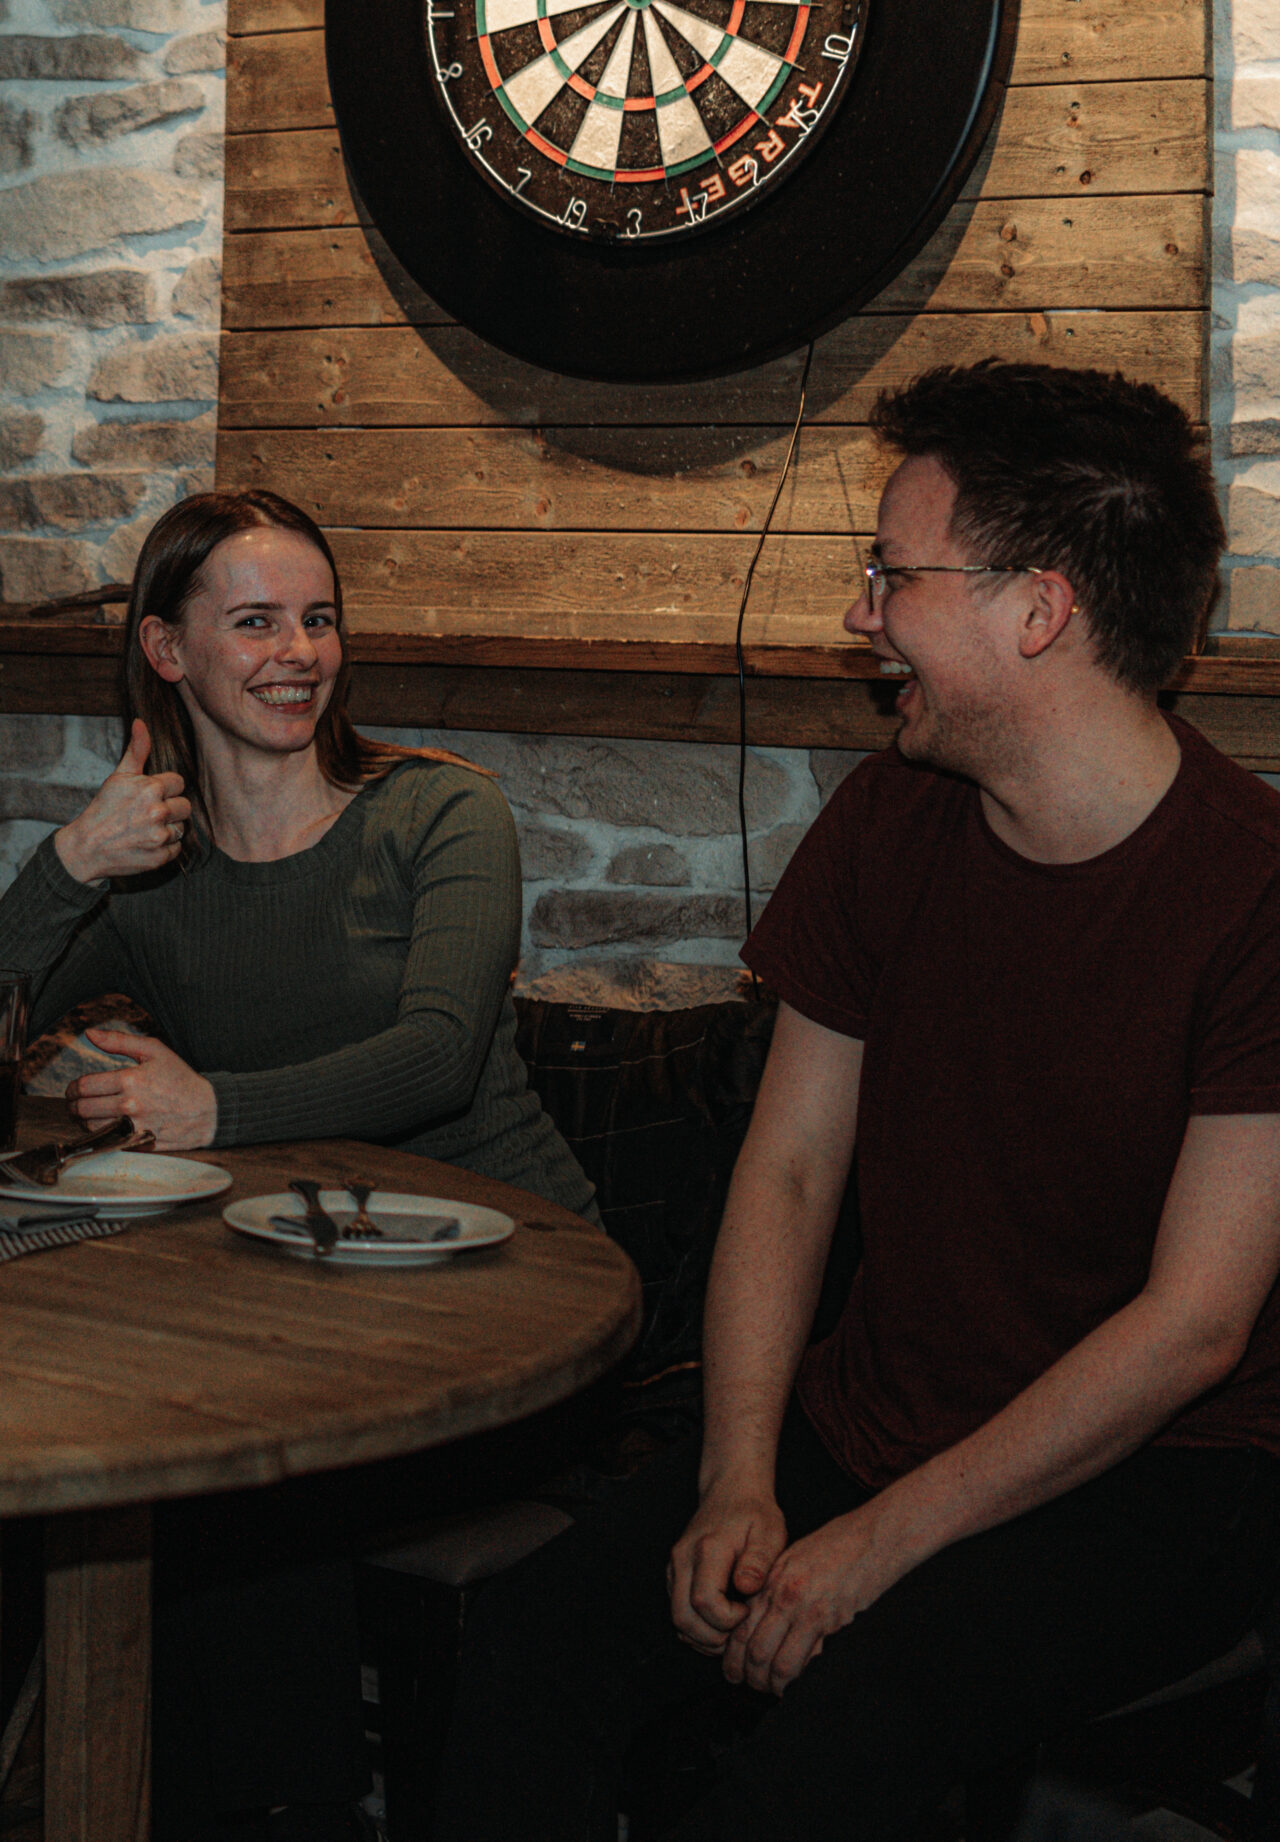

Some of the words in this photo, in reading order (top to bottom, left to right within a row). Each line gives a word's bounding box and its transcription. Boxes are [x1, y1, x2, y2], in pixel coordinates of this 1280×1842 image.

[821, 34, 852, 69] 10
[436, 62, 463, 83] 8
[462, 117, 493, 150] 16
[790, 99, 821, 138] 15
[675, 81, 824, 216] TARGET
[509, 166, 532, 194] 7
[744, 158, 766, 187] 2
[557, 196, 590, 232] 19
[626, 208, 643, 239] 3
[684, 191, 709, 227] 17
